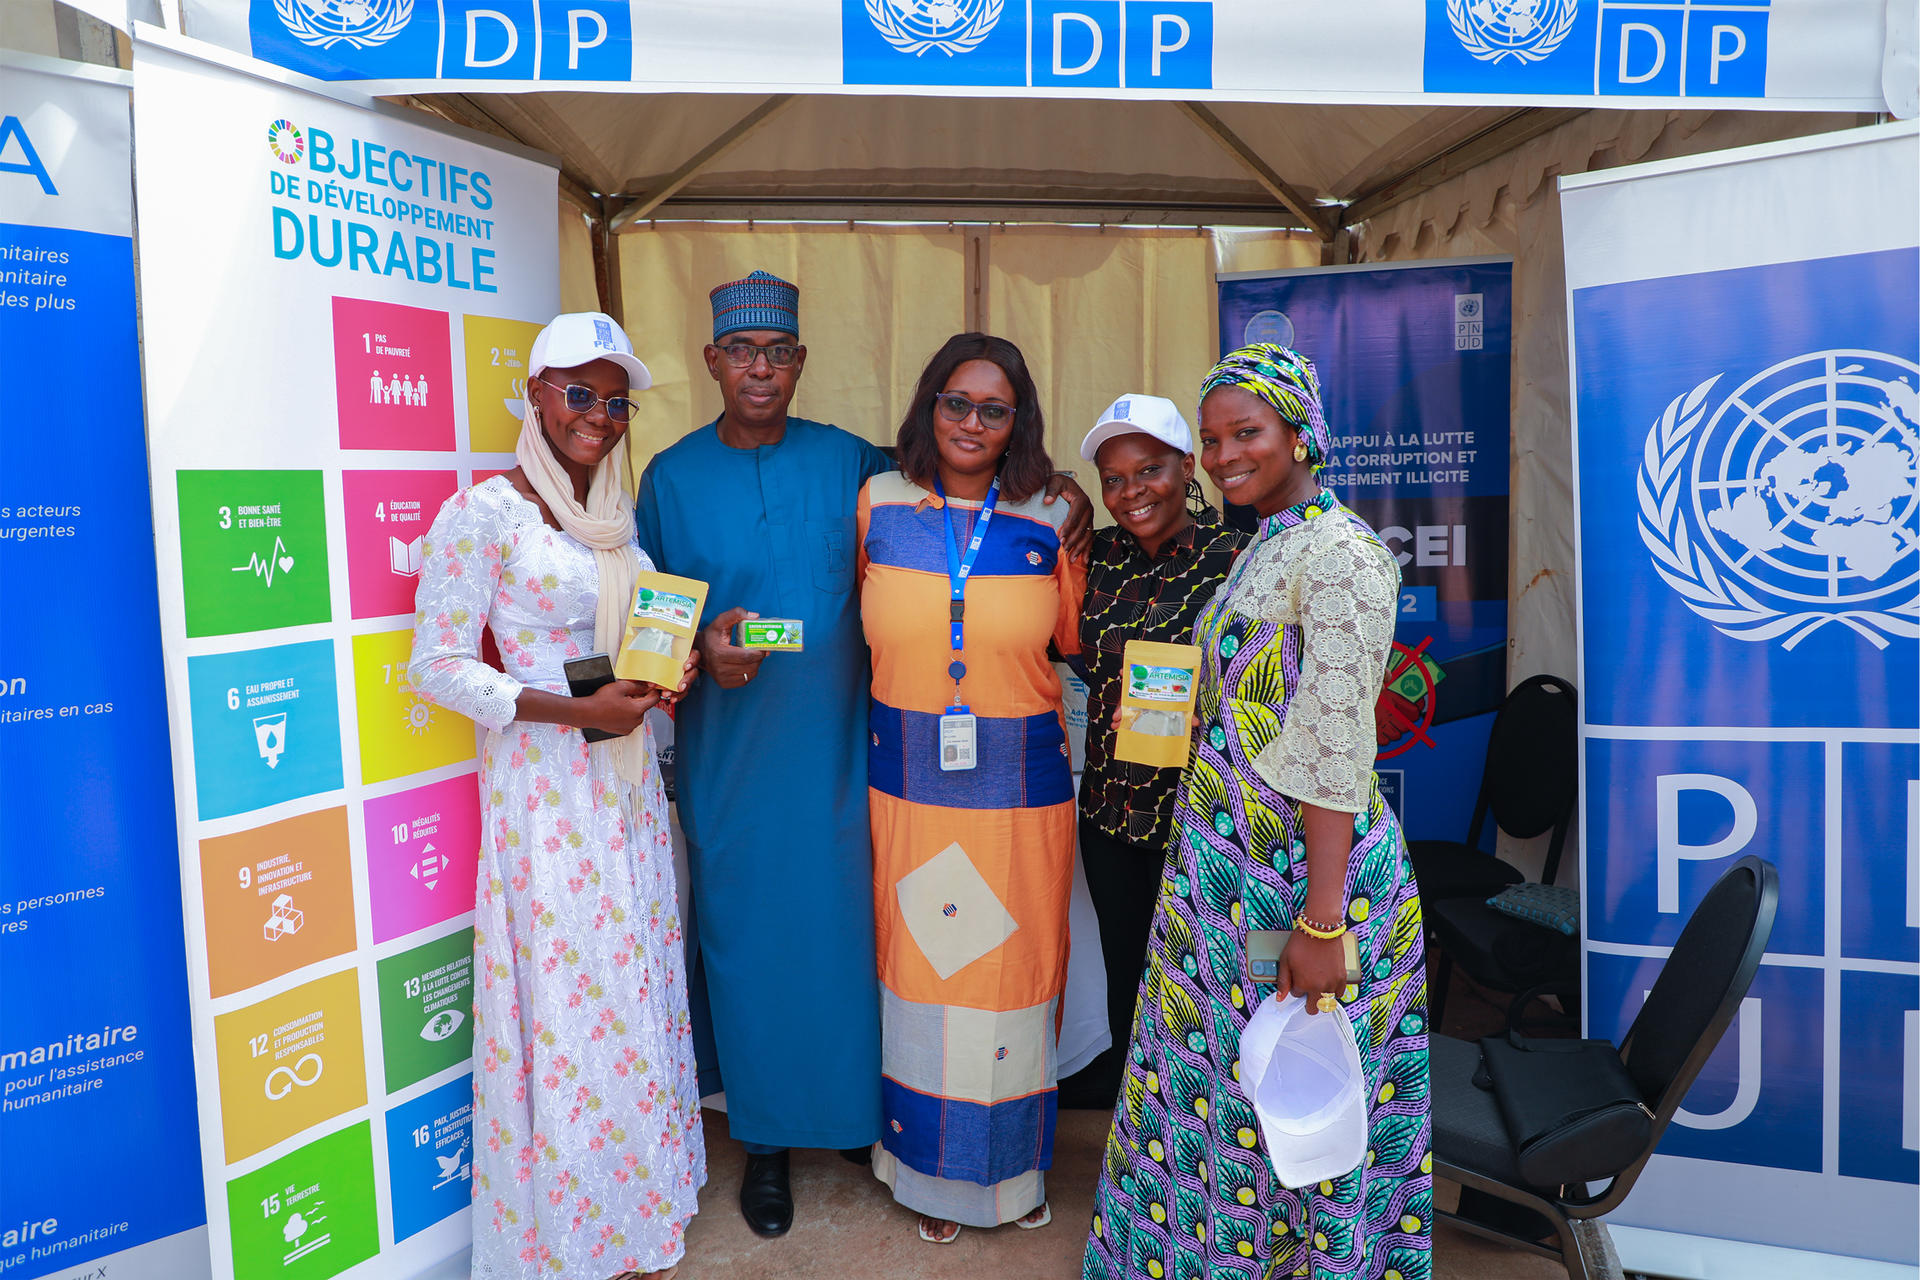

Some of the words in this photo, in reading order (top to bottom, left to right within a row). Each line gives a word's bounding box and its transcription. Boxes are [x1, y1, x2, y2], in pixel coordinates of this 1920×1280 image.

[465, 9, 519, 68] D
[567, 9, 608, 70] P
[1052, 12, 1103, 76] D
[1151, 13, 1191, 77] P
[1618, 22, 1667, 84] D
[1709, 24, 1747, 85] P
[0, 115, 60, 197] A
[270, 170, 301, 201] DE
[307, 178, 495, 241] DÉVELOPPEMENT
[272, 205, 499, 294] DURABLE
[35, 292, 77, 313] plus
[362, 332, 372, 354] 1
[374, 333, 388, 344] PAS
[375, 345, 384, 355] DE
[384, 346, 412, 359] PAUVRETÉ
[490, 347, 501, 367] 2
[1330, 434, 1380, 449] APPUI
[1383, 431, 1396, 447] À
[1399, 432, 1420, 446] LA
[1423, 431, 1475, 446] LUTTE
[1345, 451, 1453, 467] CORRUPTION
[1457, 450, 1477, 464] ET
[1406, 470, 1470, 485] ILLICITE
[16, 504, 81, 518] acteurs
[238, 505, 261, 516] BONNE
[261, 502, 281, 515] SANTÉ
[375, 501, 386, 523] 4
[390, 499, 421, 511] ÉDUCATION
[390, 513, 399, 522] DE
[399, 510, 421, 522] QUALITÉ
[218, 506, 232, 530] 3
[238, 518, 247, 529] ET
[248, 515, 282, 528] BIEN-ÊTRE
[0, 524, 76, 542] urgentes
[655, 595, 693, 609] ARTEMISIA
[1402, 594, 1417, 613] 2
[382, 664, 392, 685] 7
[1149, 671, 1190, 682] ARTEMISIA
[245, 684, 260, 696] EAU
[260, 679, 286, 693] PROPRE
[286, 677, 294, 688] ET
[227, 687, 240, 711] 6
[246, 689, 300, 709] ASSAINISSEMENT
[1, 707, 54, 724] itaires
[59, 704, 79, 717] en
[84, 702, 114, 715] cas
[412, 811, 441, 829] INÉGALITÉS
[391, 823, 408, 845] 10
[412, 825, 438, 840] RÉDUITES
[1656, 773, 1758, 914] P
[238, 866, 252, 889] 9
[257, 864, 295, 884] INNOVATION
[295, 861, 303, 872] ET
[258, 870, 313, 897] INFRASTRUCTURE
[16, 886, 105, 915] personnes
[421, 966, 446, 983] MESURES
[446, 955, 472, 973] RELATIVES
[427, 981, 435, 991] LA
[434, 974, 450, 988] LUTTE
[450, 966, 470, 981] CONTRE
[403, 976, 421, 999] 13
[423, 992, 433, 1004] LES
[433, 977, 471, 999] CHANGEMENTS
[423, 992, 458, 1014] CLIMATIQUES
[273, 1009, 324, 1037] CONSOMMATION
[248, 1032, 270, 1058] 12
[274, 1037, 282, 1049] ET
[282, 1021, 325, 1045] PRODUCTION
[275, 1032, 326, 1061] RESPONSABLES
[4, 1072, 46, 1096] pour
[49, 1049, 145, 1083] l'assistance
[2, 1077, 104, 1113] humanitaire
[434, 1114, 449, 1128] PAIX,
[412, 1124, 430, 1149] 16
[434, 1128, 441, 1139] ET
[435, 1129, 465, 1150] EFFICACES
[284, 1183, 296, 1196] VIE
[286, 1182, 321, 1207] TERRESTRE
[260, 1192, 281, 1219] 15
[31, 1221, 129, 1260] humanitaire
